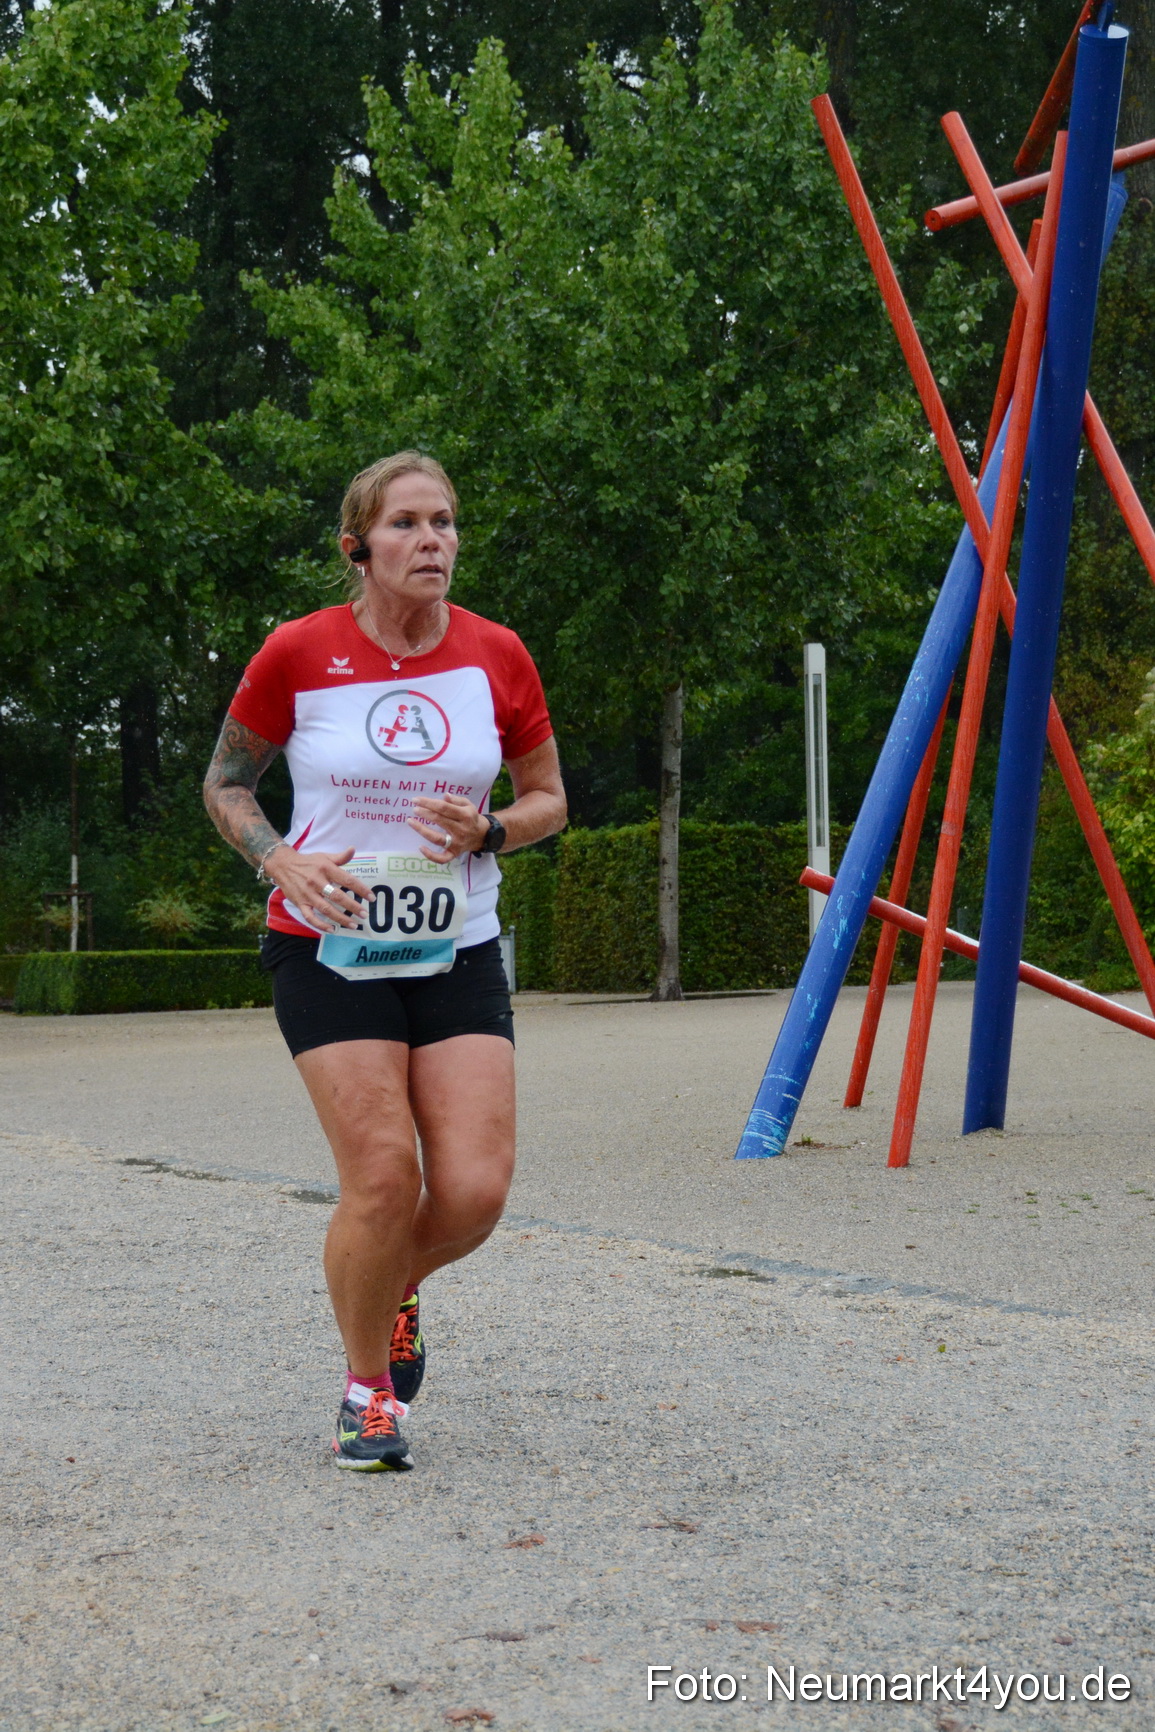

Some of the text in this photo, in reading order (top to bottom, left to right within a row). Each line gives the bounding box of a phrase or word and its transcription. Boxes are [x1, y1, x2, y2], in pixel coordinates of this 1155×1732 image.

[327, 667, 354, 675] erima
[346, 794, 361, 804] Dr.
[364, 796, 391, 806] Heck
[388, 856, 453, 876] BOCK
[356, 945, 422, 963] Annette
